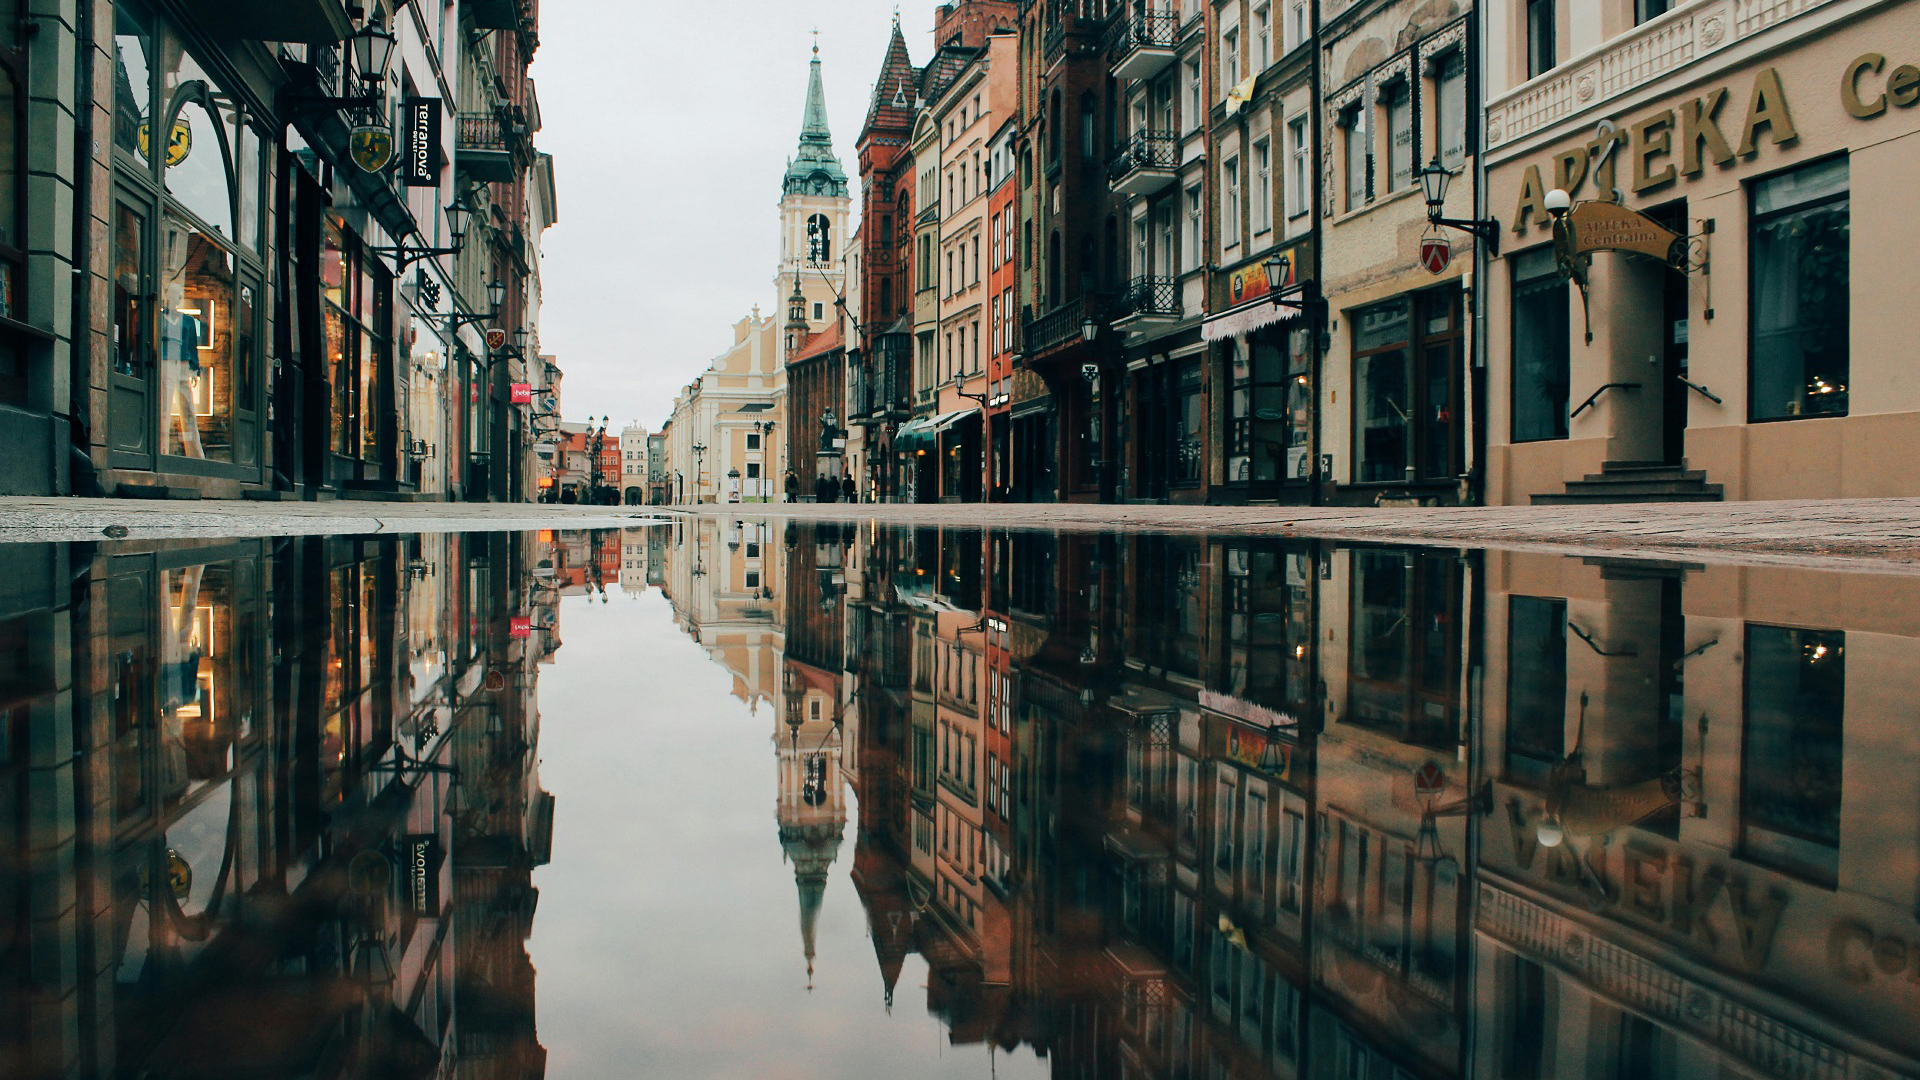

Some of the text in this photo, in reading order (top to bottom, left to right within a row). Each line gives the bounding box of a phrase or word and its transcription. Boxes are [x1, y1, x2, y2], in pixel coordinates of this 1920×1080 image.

[1512, 52, 1920, 231] APTEKA Ce
[1584, 218, 1642, 232] APTEKA
[1584, 231, 1658, 245] Centralna
